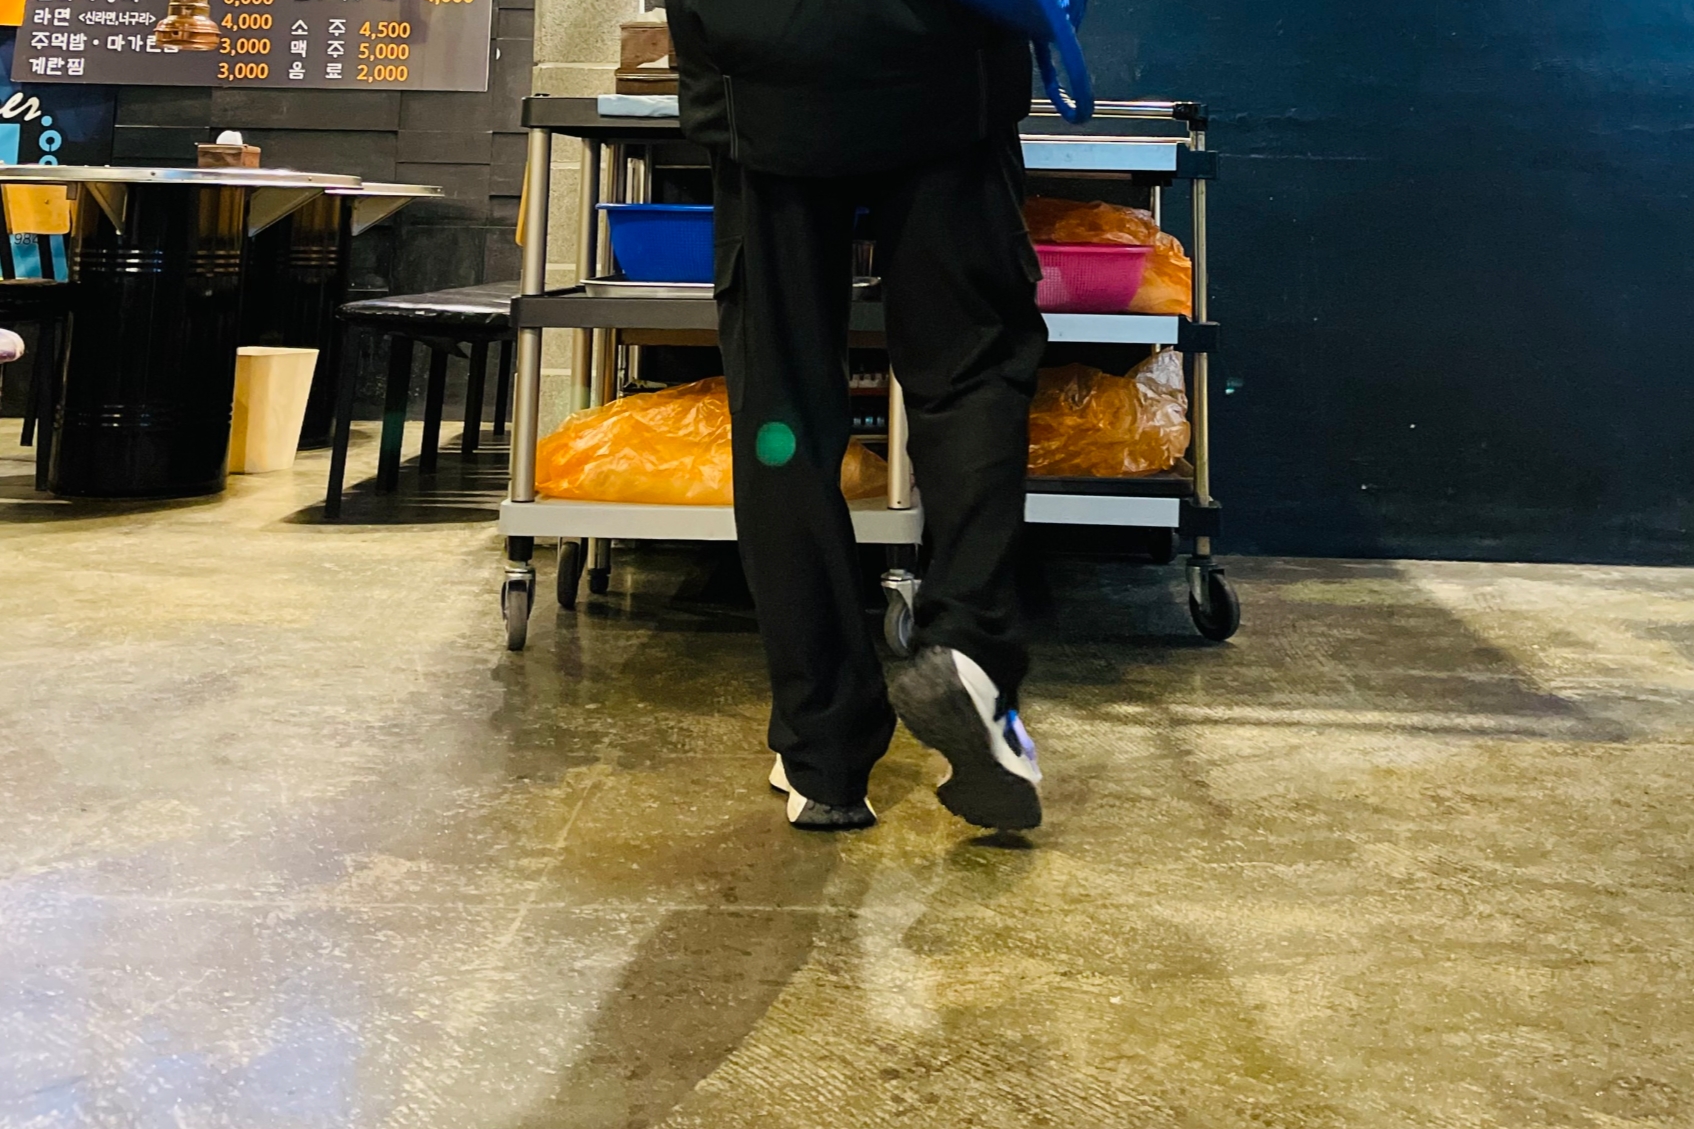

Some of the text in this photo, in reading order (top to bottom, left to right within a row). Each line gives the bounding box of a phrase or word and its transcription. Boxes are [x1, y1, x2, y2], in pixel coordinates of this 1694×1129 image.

[33, 7, 71, 26] 라면
[221, 13, 273, 32] 4,000
[359, 21, 411, 40] 4,500
[31, 31, 87, 51] 주먹밥
[219, 37, 271, 57] 3,000
[358, 42, 410, 62] 5,000
[29, 56, 269, 81] 계란찜 3,000
[356, 64, 408, 83] 2,000
